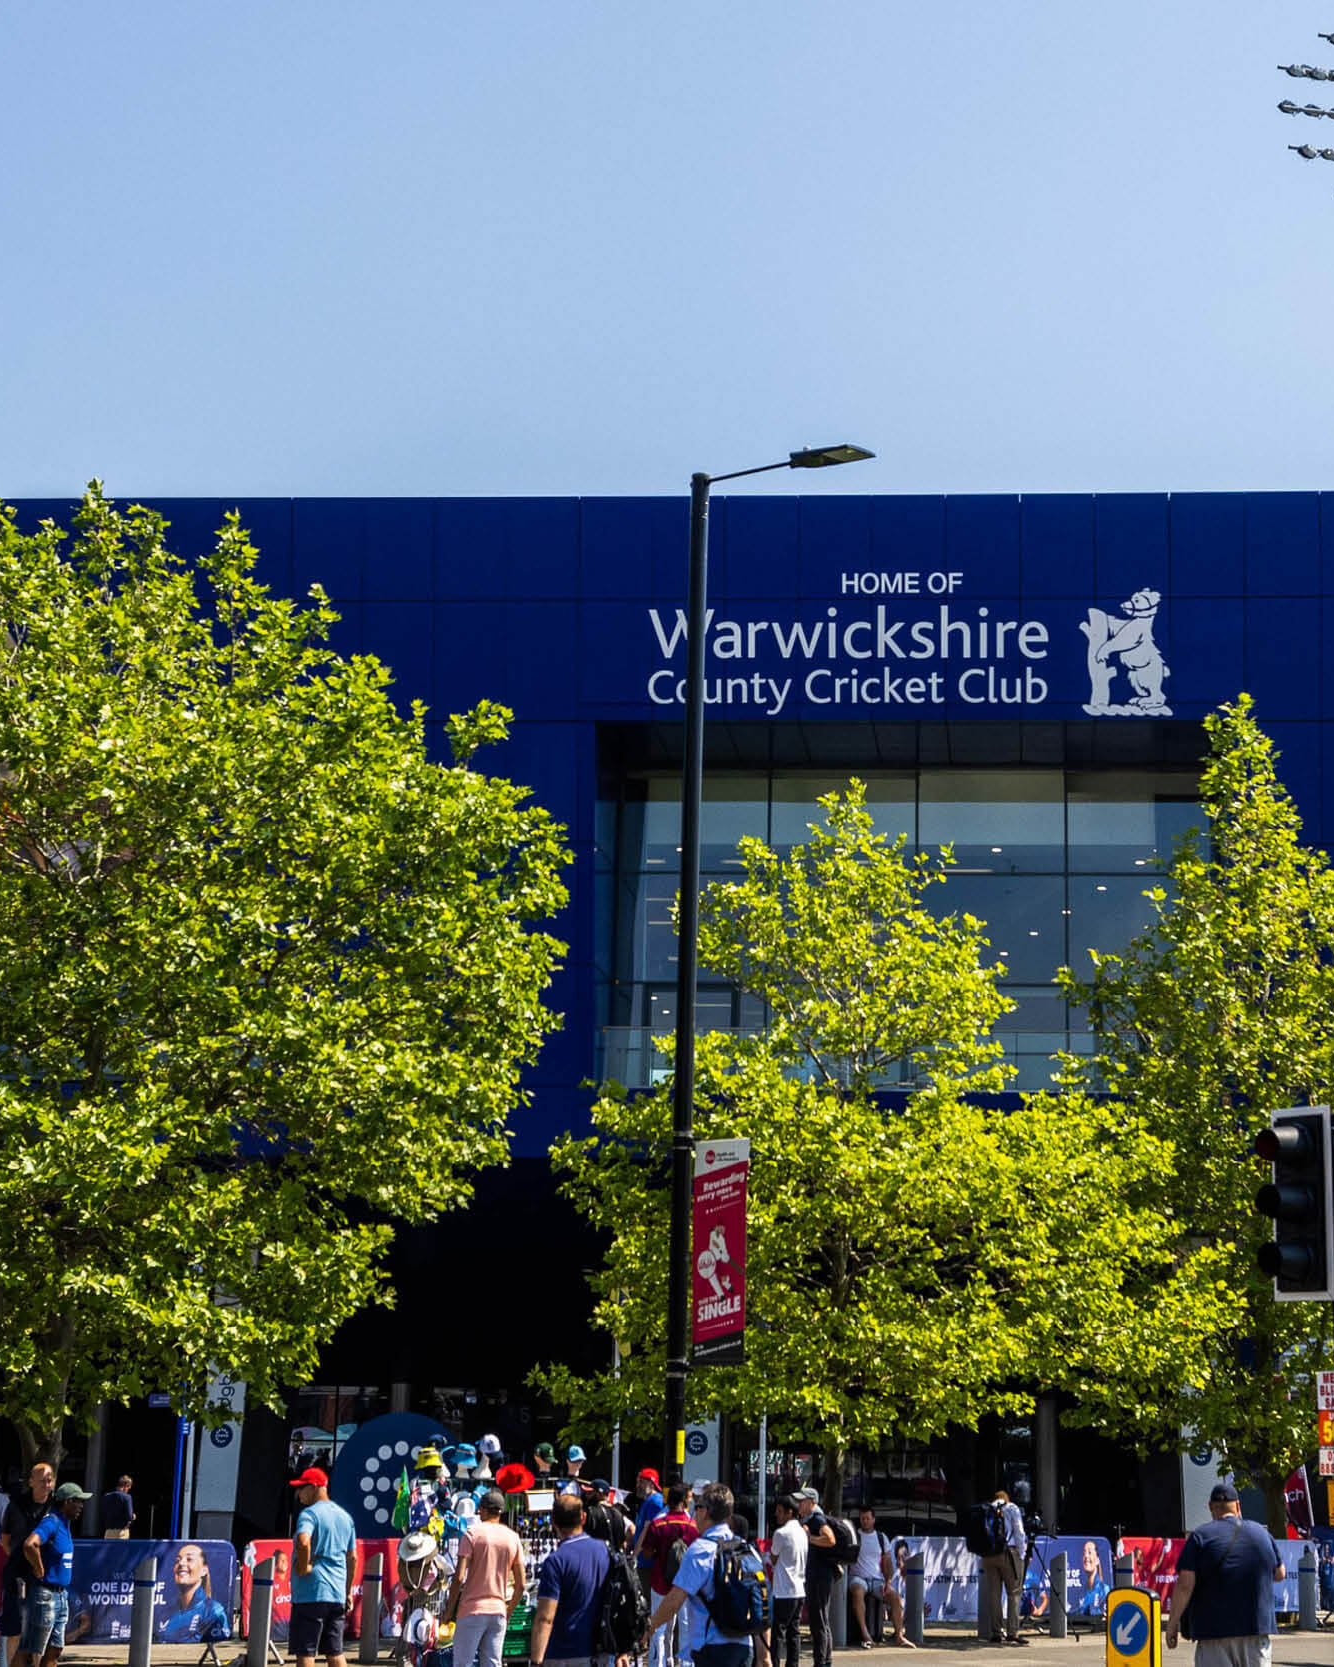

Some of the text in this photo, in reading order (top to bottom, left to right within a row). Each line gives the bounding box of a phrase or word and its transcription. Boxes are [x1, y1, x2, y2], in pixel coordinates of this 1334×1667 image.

[841, 572, 964, 594] HOME OF
[648, 605, 1050, 660] Warwickshire
[804, 668, 945, 705] Cricket
[958, 668, 1049, 705] Club
[703, 1171, 745, 1193] Rewarding
[697, 1294, 741, 1323] SINGLE
[91, 1581, 118, 1593] ONE
